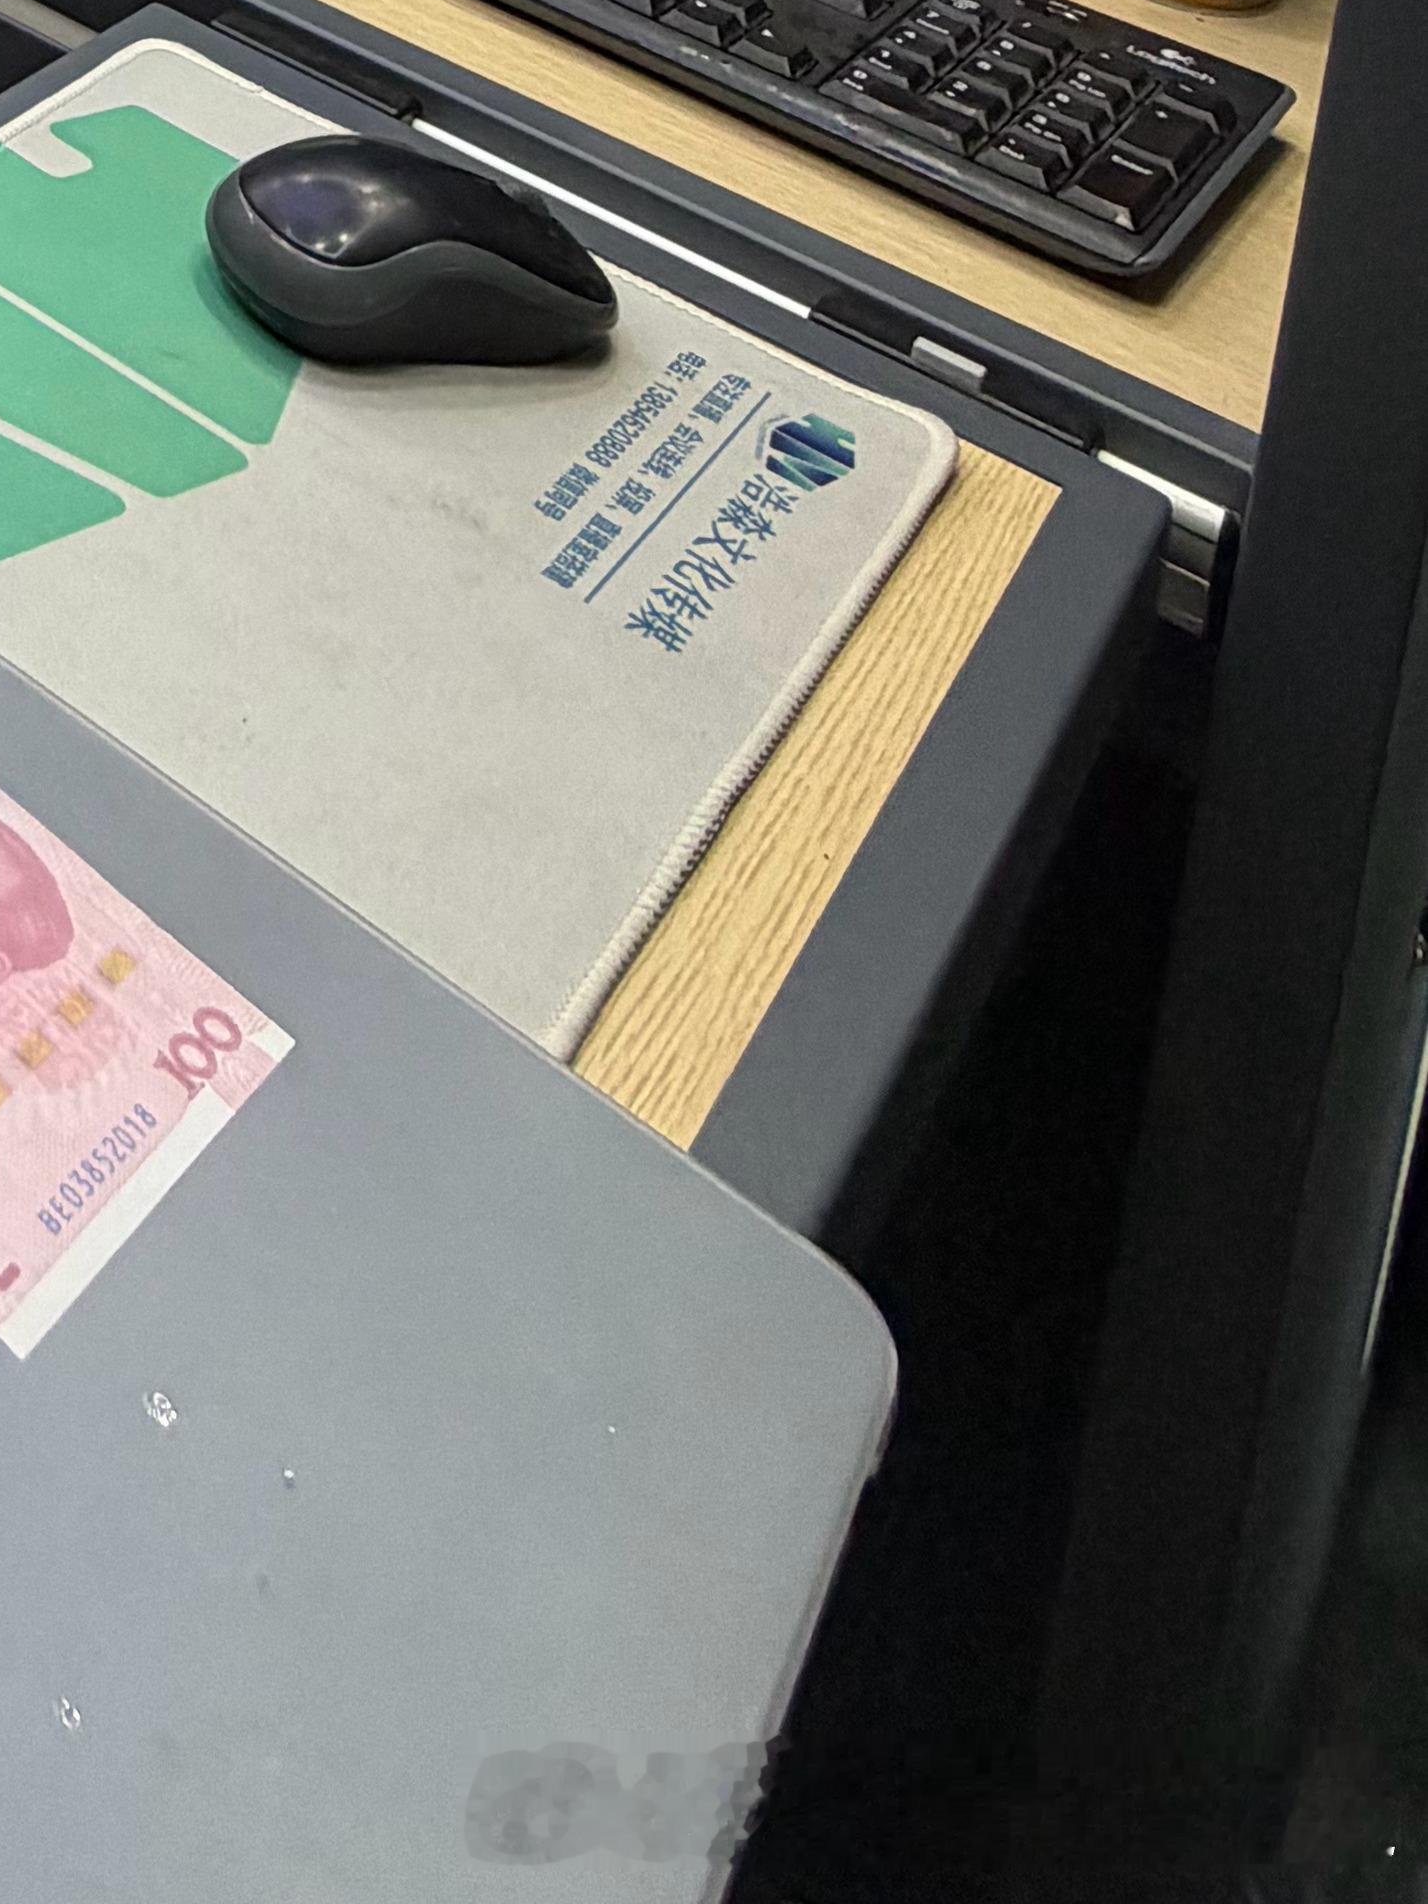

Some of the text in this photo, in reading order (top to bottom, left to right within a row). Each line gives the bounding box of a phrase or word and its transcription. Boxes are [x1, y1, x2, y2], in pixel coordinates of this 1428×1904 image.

[623, 472, 800, 654] 浩淼文化传媒
[152, 1006, 242, 1095] 100
[35, 1102, 161, 1239] BE03852018
